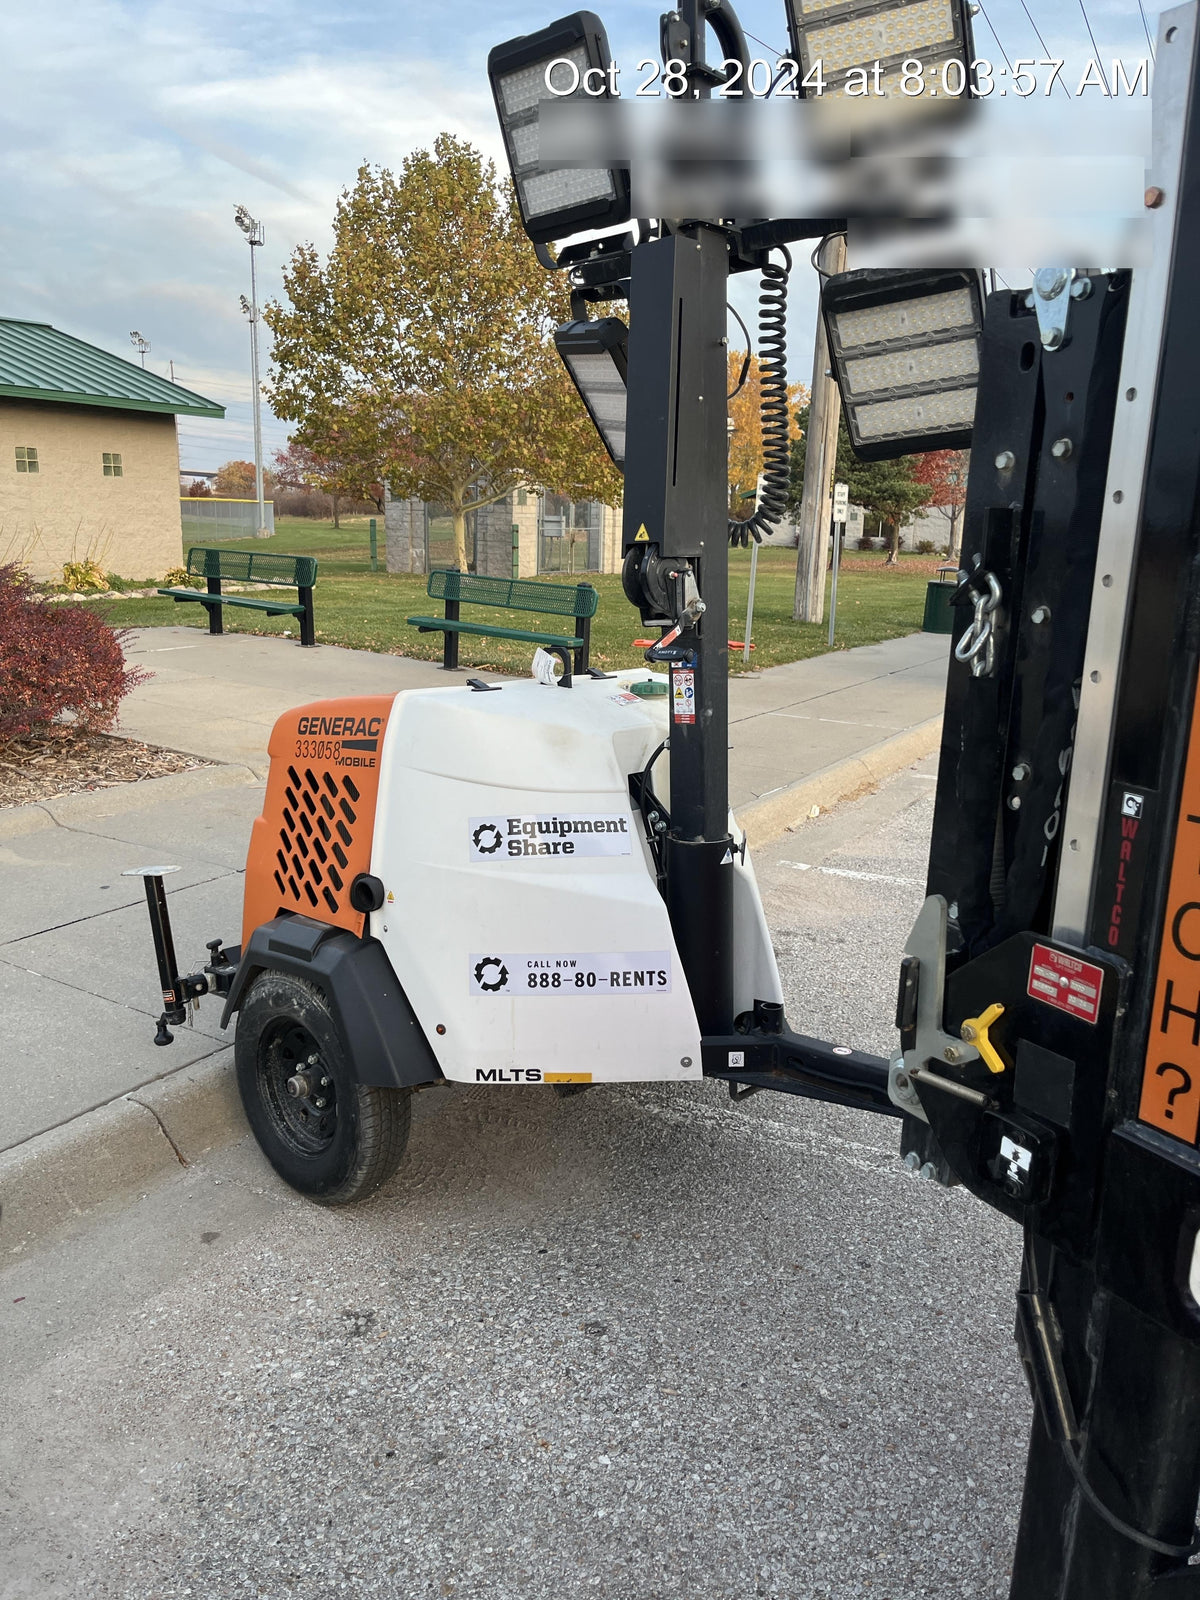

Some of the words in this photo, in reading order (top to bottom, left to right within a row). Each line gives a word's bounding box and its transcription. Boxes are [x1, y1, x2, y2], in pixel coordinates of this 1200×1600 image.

[298, 717, 381, 736] GENERAC
[295, 740, 340, 760] 333058
[336, 757, 375, 767] MOBILE
[507, 817, 628, 838] Equipment
[508, 839, 575, 857] Share
[1108, 817, 1139, 946] WALTCO
[556, 960, 577, 968] NOW
[527, 970, 667, 988] 888-80-RENTS
[476, 1069, 542, 1082] MLTS
